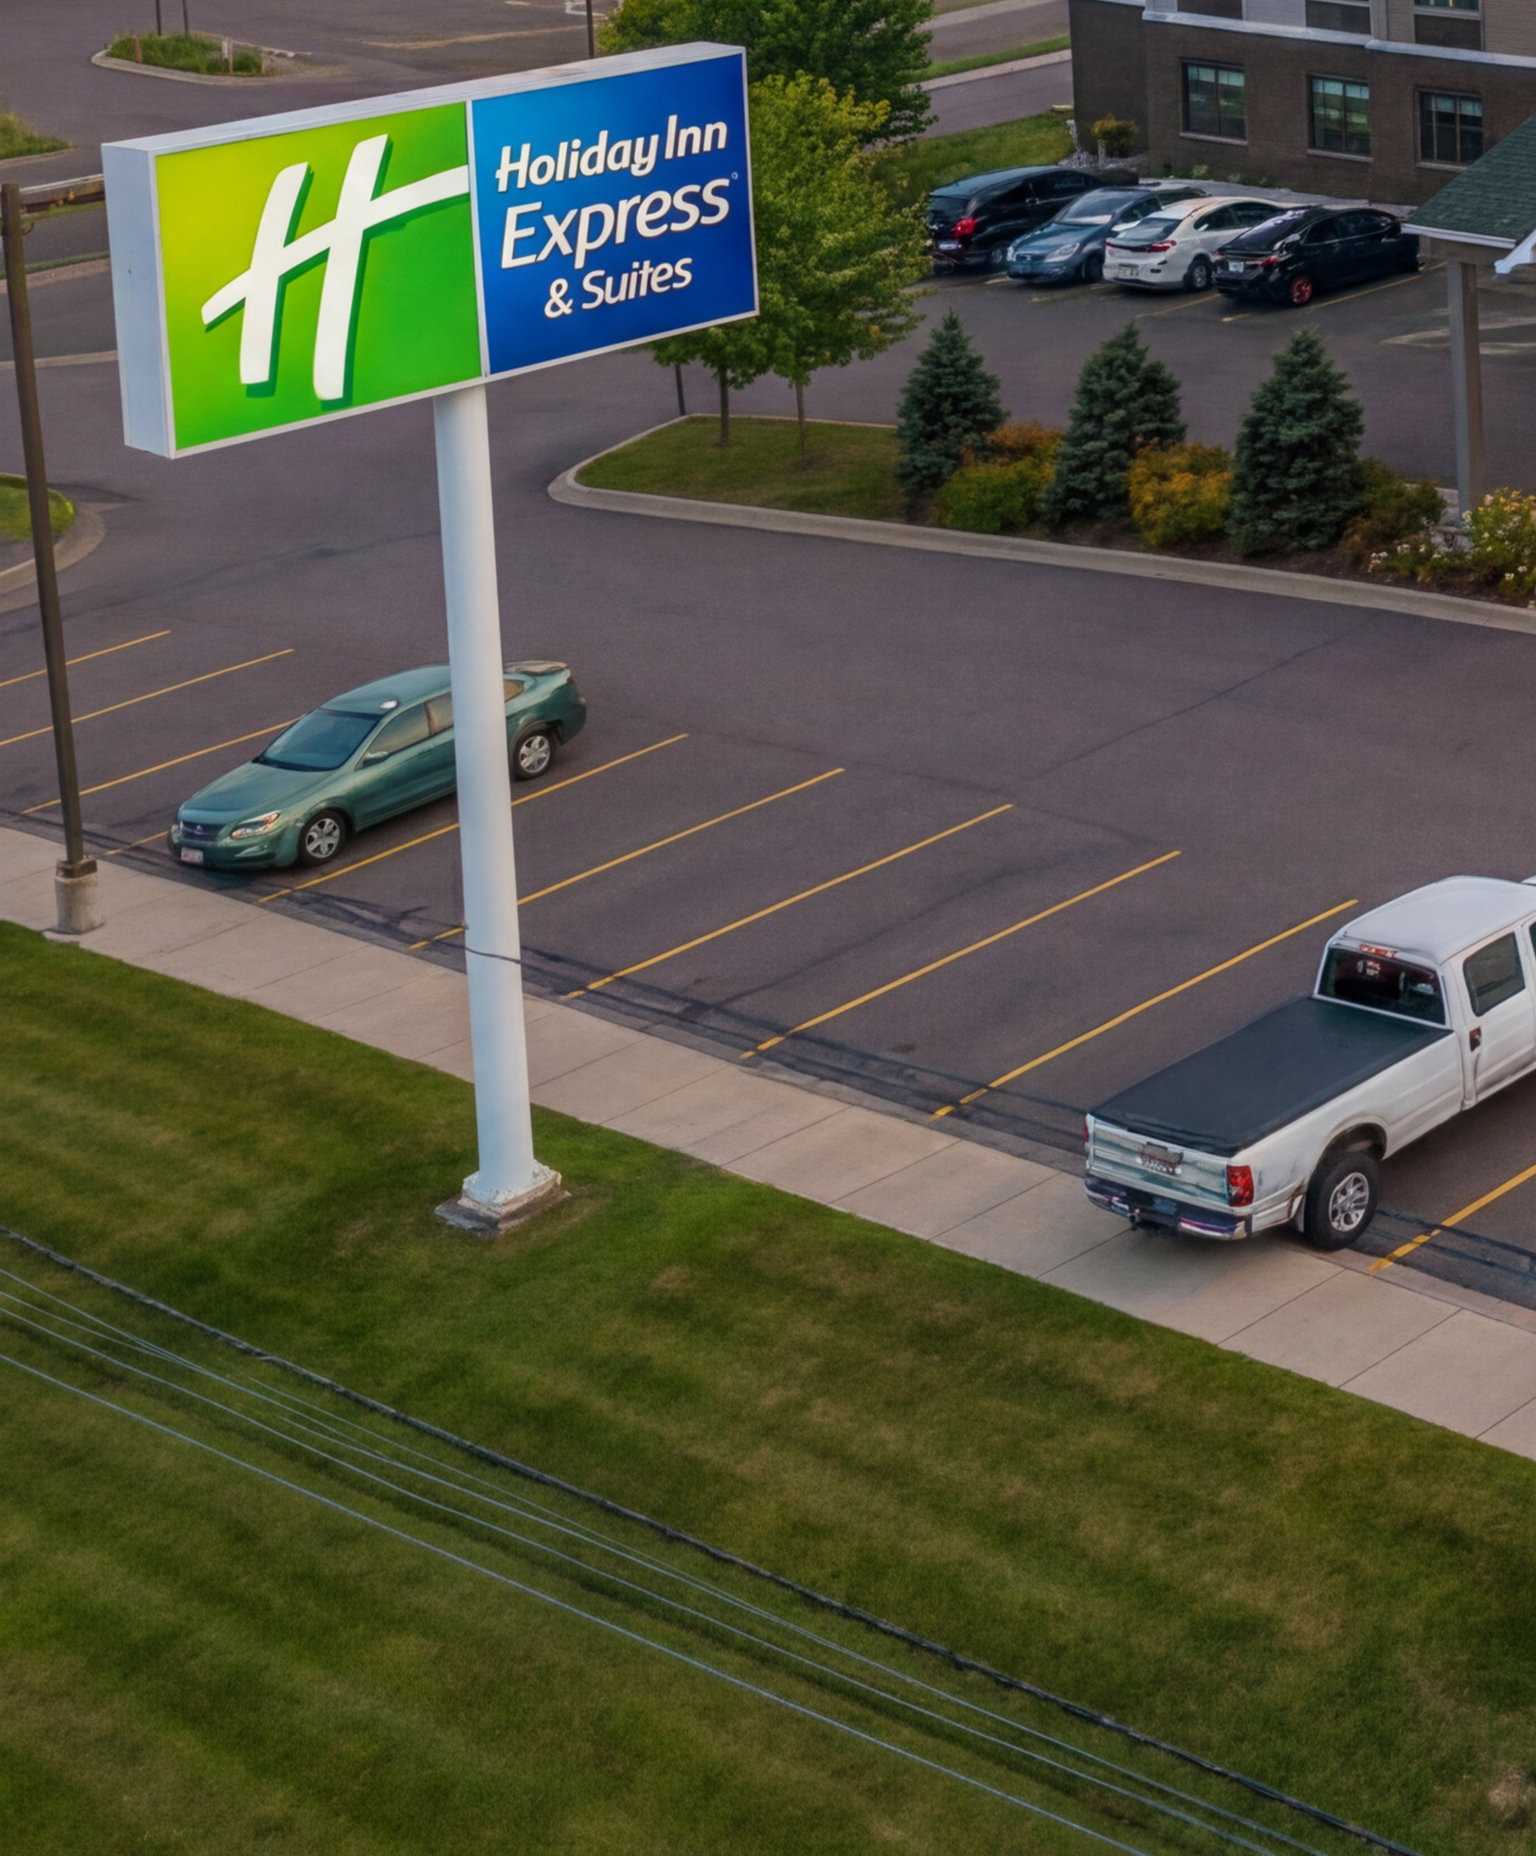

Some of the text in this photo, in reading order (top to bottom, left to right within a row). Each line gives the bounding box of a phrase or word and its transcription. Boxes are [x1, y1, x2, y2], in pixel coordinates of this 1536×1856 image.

[495, 114, 727, 193] Holiday Inn
[500, 178, 730, 270] Express
[543, 257, 693, 319] & Suites
